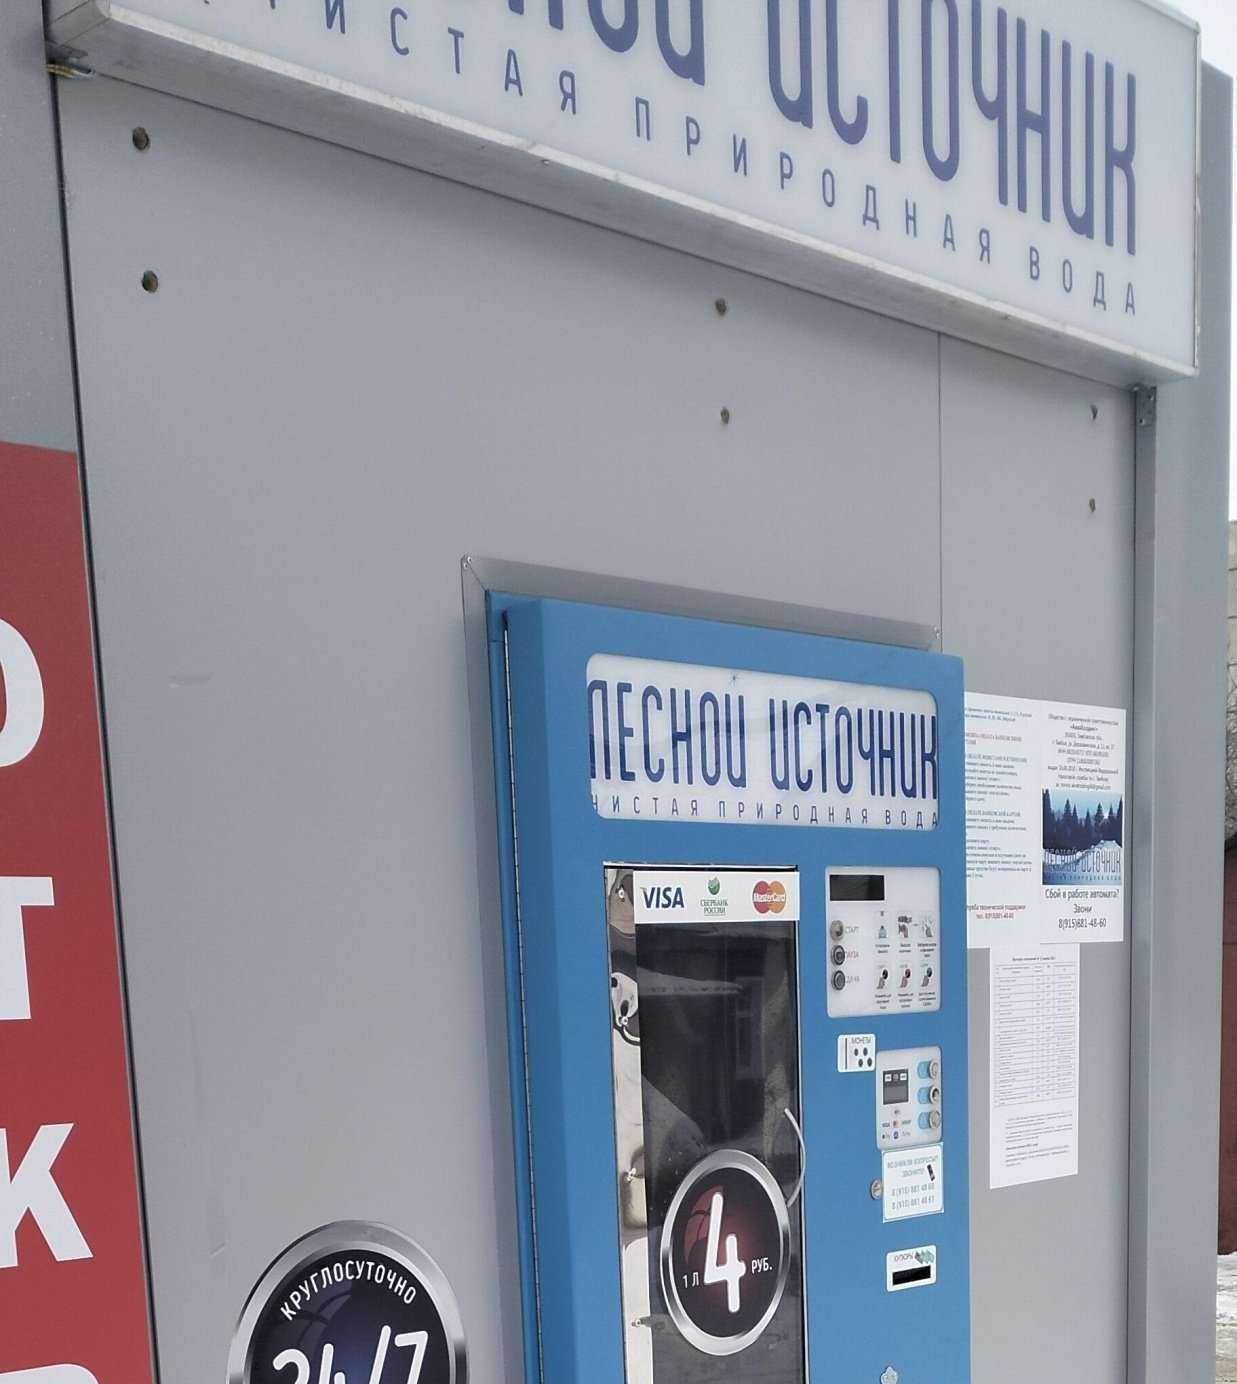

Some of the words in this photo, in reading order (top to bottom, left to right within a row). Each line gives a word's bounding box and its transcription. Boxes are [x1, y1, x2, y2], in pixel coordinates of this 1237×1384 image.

[635, 96, 992, 265] ПРИРОДНАЯ
[1029, 245, 1136, 317] ВОДА
[769, 698, 938, 800] ИСТОЧНИК
[592, 793, 698, 815] ЧИСТАЯ
[719, 800, 869, 825] ПРИРОДНАЯ
[885, 810, 938, 829] ВОДА
[641, 887, 686, 909] VISA
[700, 899, 729, 907] СБЕРБАНК
[1045, 888, 1062, 899] Сбой
[1068, 888, 1089, 901] работе
[1090, 888, 1120, 898] автомата?
[1073, 904, 1093, 913] Звони
[682, 1274, 689, 1289] 1
[703, 1192, 747, 1313] 4
[751, 1257, 773, 1274] РУБ.
[280, 1260, 417, 1321] КРУГЛОСУТОЧНО
